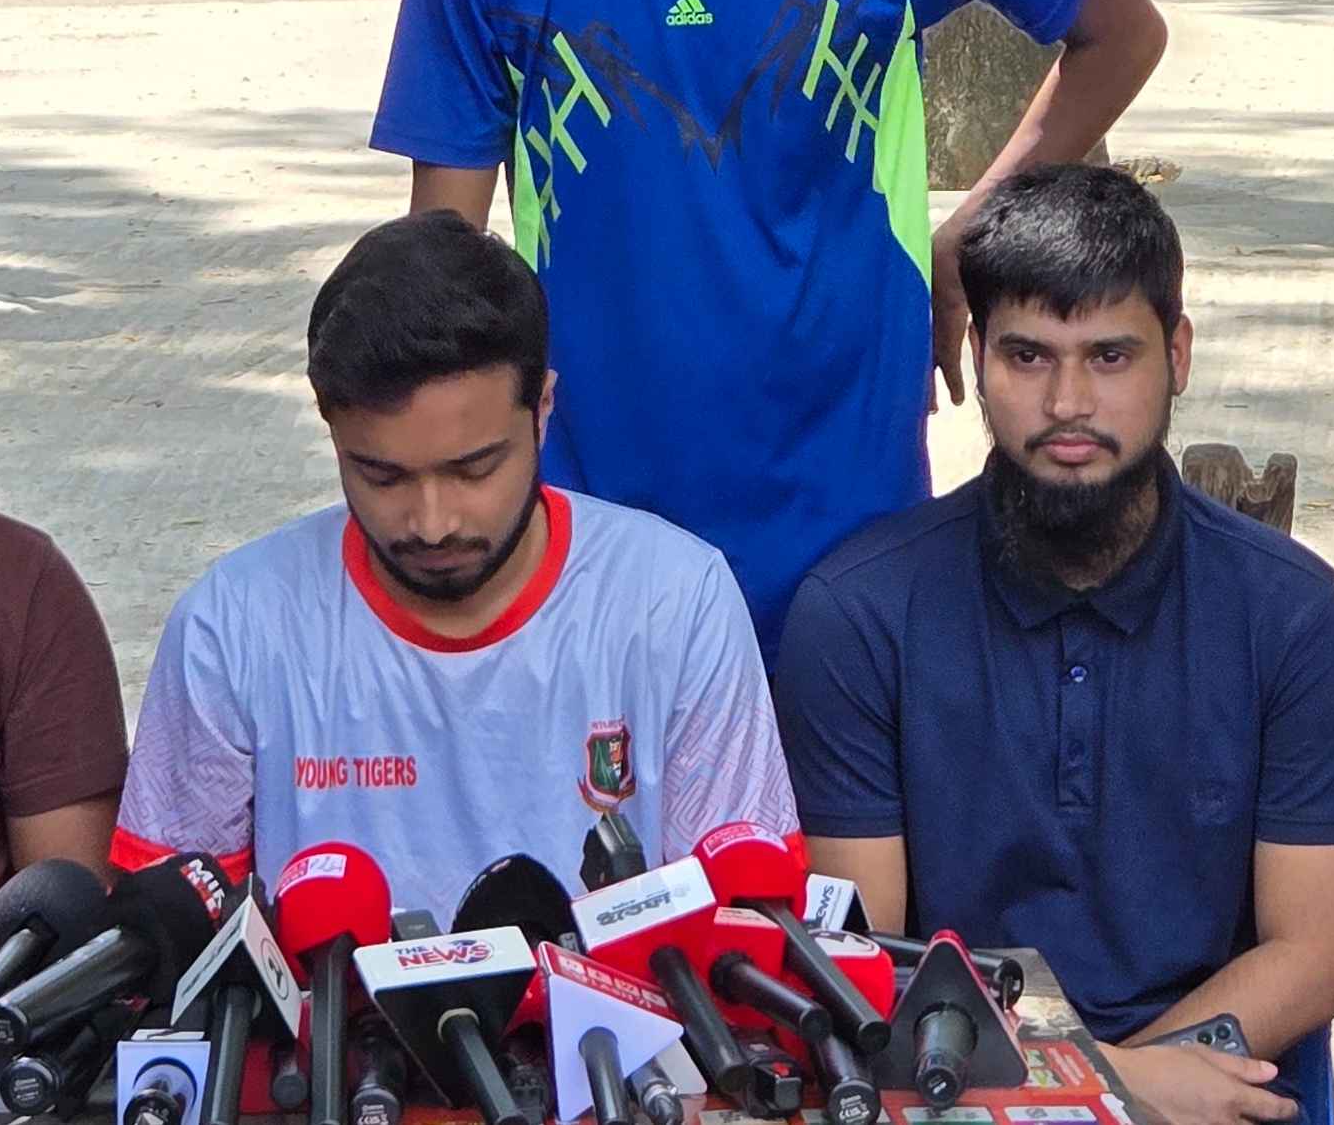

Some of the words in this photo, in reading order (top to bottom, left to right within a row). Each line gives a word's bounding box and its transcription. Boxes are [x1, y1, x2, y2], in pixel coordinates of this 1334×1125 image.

[665, 11, 713, 27] adidas
[296, 756, 348, 789] YOUNG
[353, 755, 417, 787] TIGERS
[395, 945, 429, 955] THE
[398, 944, 490, 967] NEWS
